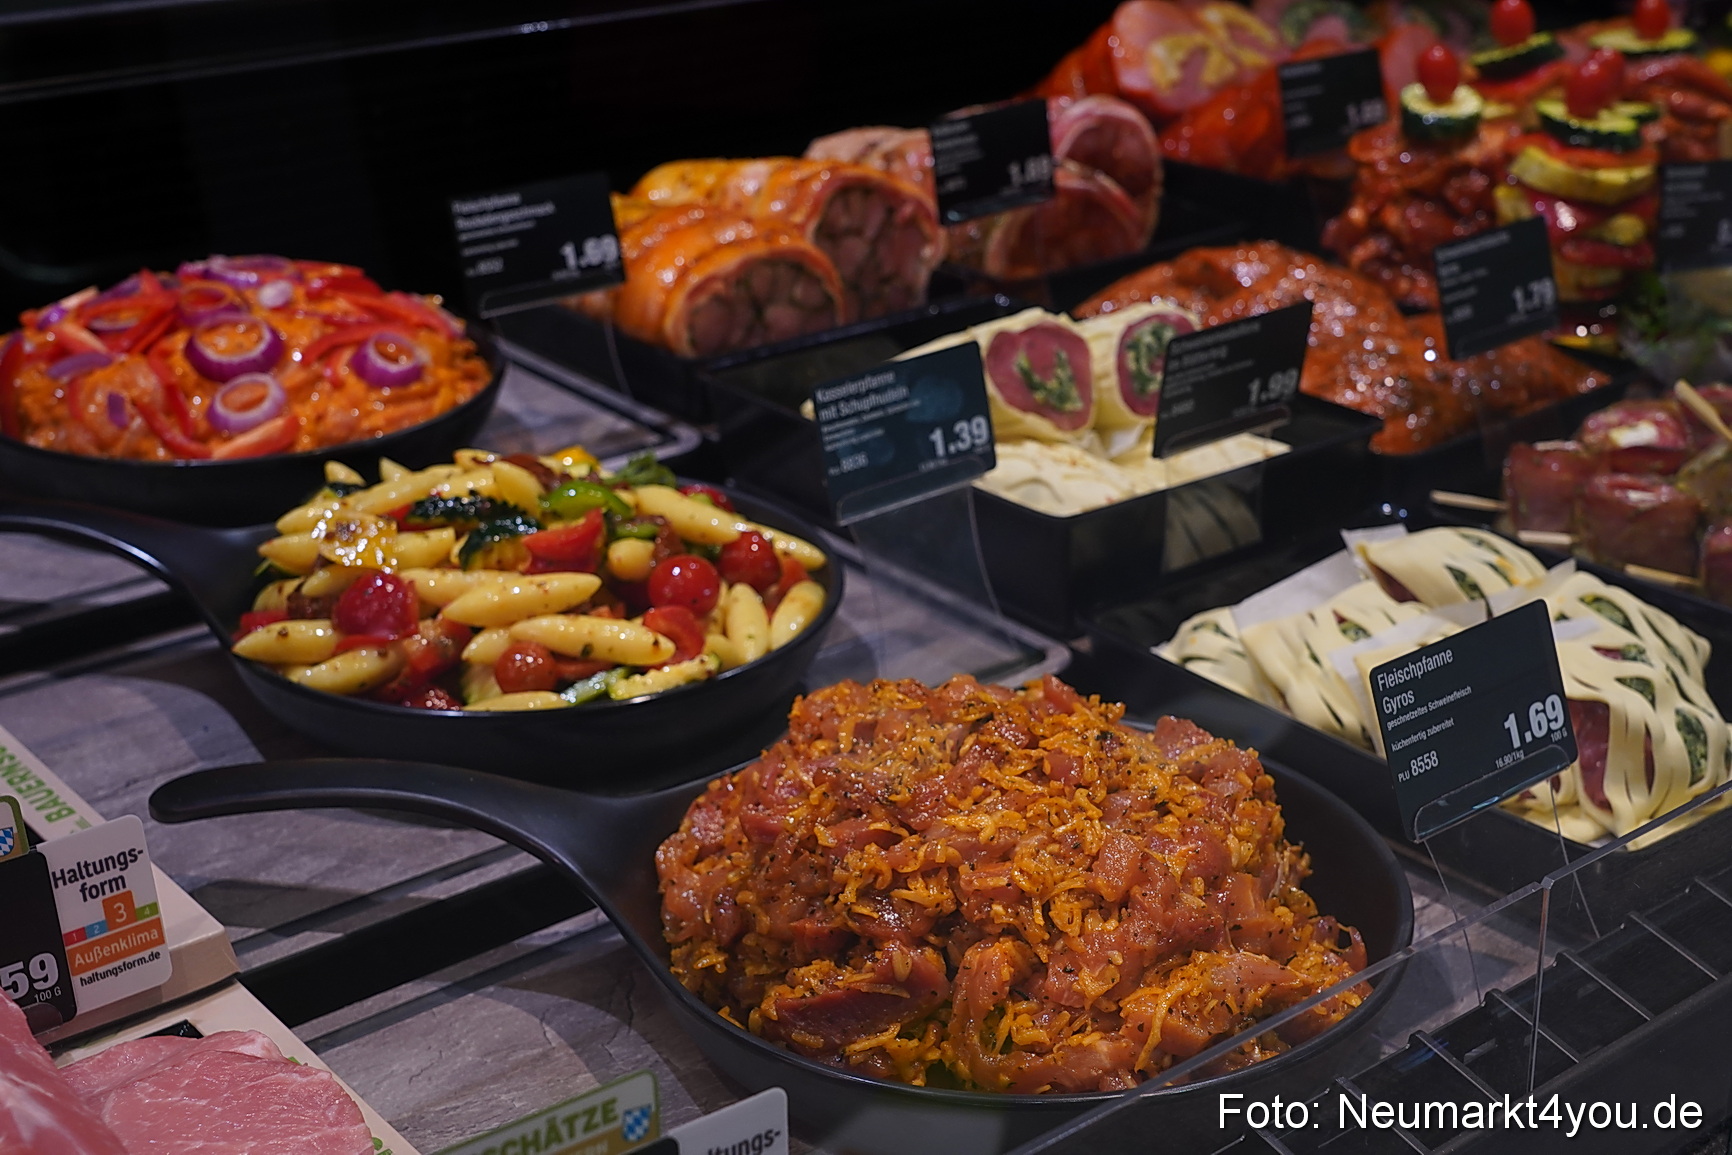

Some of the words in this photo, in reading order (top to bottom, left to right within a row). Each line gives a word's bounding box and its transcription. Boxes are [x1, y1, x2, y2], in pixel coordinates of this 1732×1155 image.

[929, 415, 990, 457] 1.39
[1377, 649, 1454, 691] Fleischpfanne
[1382, 690, 1415, 715] Gyros
[1386, 704, 1428, 731] geschnetzeltes
[1428, 686, 1472, 711] Schweinefleisch
[1391, 729, 1427, 752] küchenfertig
[1427, 717, 1455, 736] zubereitet
[1503, 694, 1565, 749] 1.69
[1398, 771, 1410, 782] PLU
[1410, 750, 1439, 776] 8558
[1495, 749, 1525, 769] 16.90/1kg
[51, 848, 144, 890] Haltungs-
[79, 874, 127, 903] form
[93, 924, 100, 934] 2
[113, 902, 127, 923] 3
[74, 928, 159, 968] Außenklima
[80, 951, 161, 987] haltungsform.de
[34, 988, 52, 1003] 100
[54, 986, 62, 997] G
